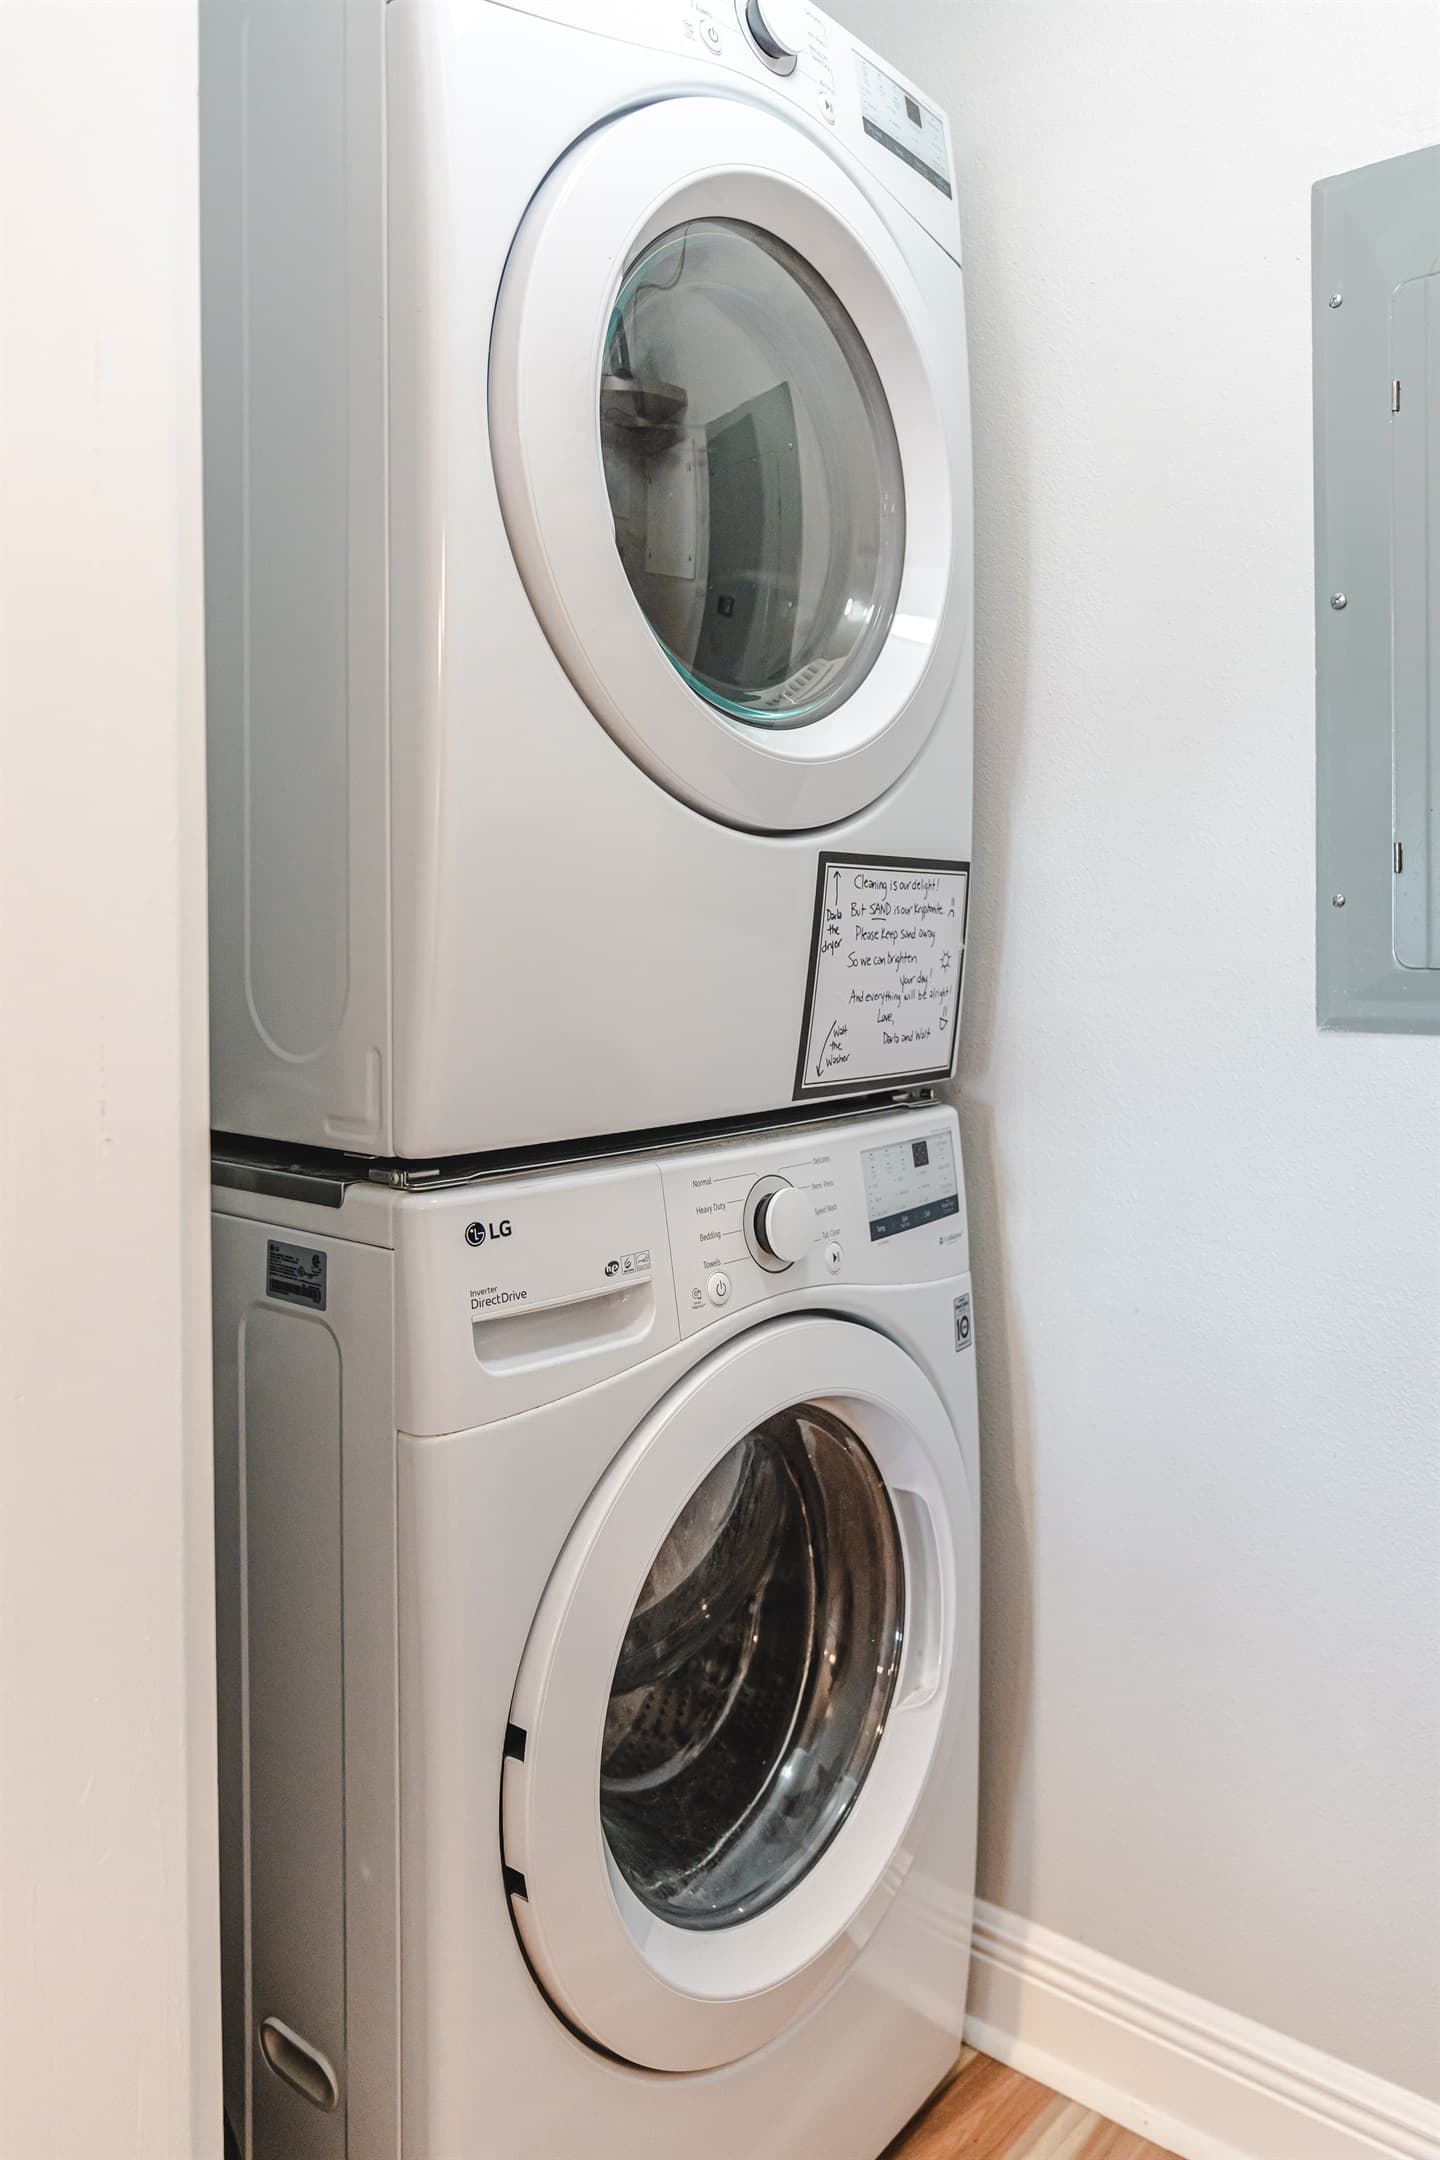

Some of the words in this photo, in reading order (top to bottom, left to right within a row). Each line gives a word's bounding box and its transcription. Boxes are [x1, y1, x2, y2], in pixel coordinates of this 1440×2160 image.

[854, 873, 887, 901] Cleaning
[890, 880, 897, 891] is
[899, 881, 911, 890] our
[851, 902, 867, 917] But
[869, 902, 891, 916] SAND
[894, 905, 900, 915] is
[901, 905, 913, 915] our
[827, 924, 840, 935] the
[855, 925, 879, 941] Please
[918, 928, 936, 948] away
[822, 938, 842, 956] dryer
[847, 952, 858, 968] So
[860, 957, 871, 967] we
[873, 956, 886, 966] can
[887, 952, 918, 973] brighten
[900, 974, 916, 993] your
[849, 989, 864, 1004] And
[865, 991, 901, 1008] everything
[904, 989, 915, 1000] will
[918, 989, 927, 1000] be
[901, 1029, 914, 1042] and
[830, 1041, 843, 1051] the
[692, 1177, 712, 1188] Normal
[696, 1205, 712, 1215] Heavy
[713, 1202, 726, 1212] Duty
[489, 1220, 513, 1240] LG
[699, 1230, 722, 1242] Bedding
[703, 1258, 722, 1269] Towels
[470, 1285, 498, 1298] Inverter
